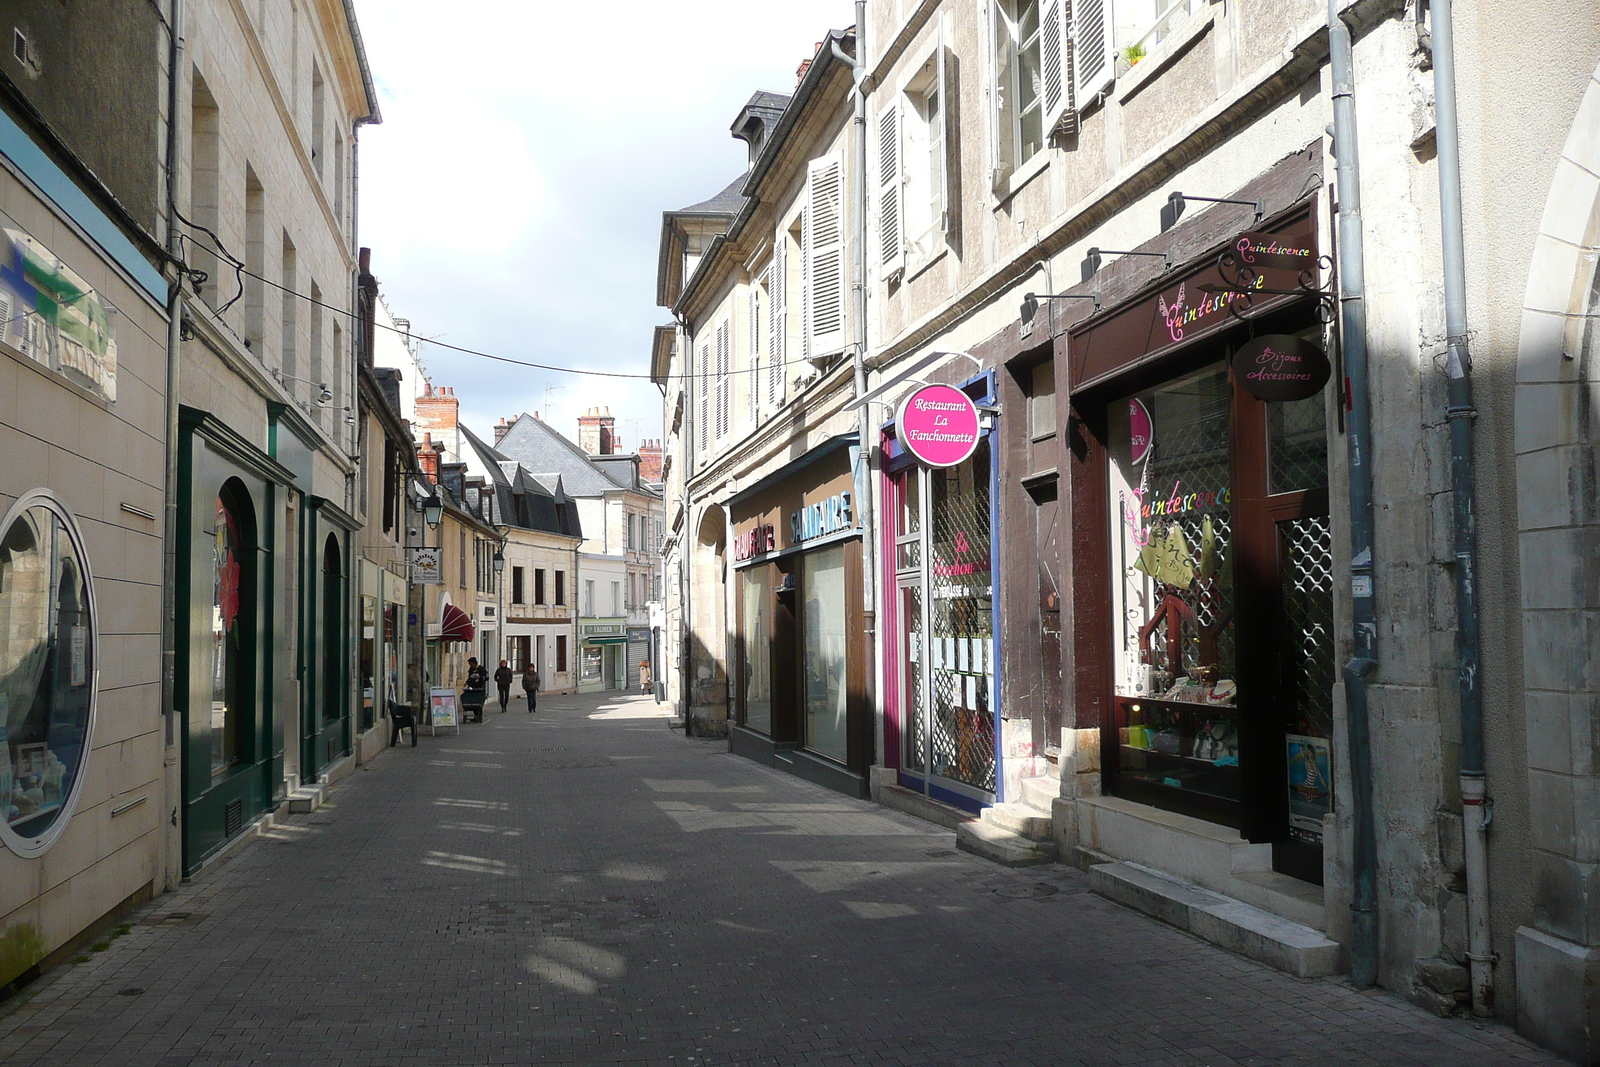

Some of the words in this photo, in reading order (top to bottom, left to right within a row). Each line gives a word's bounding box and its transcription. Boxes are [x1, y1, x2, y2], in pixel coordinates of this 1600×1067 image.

[1237, 237, 1311, 264] Quintescence
[1166, 274, 1264, 342] Quintescee
[1255, 347, 1303, 372] Bijoux
[1246, 366, 1312, 382] Accessoires
[914, 398, 967, 412] Restaurant
[933, 414, 949, 426] La
[909, 429, 974, 443] Fanchonnette
[791, 490, 852, 544] SANITAIRE
